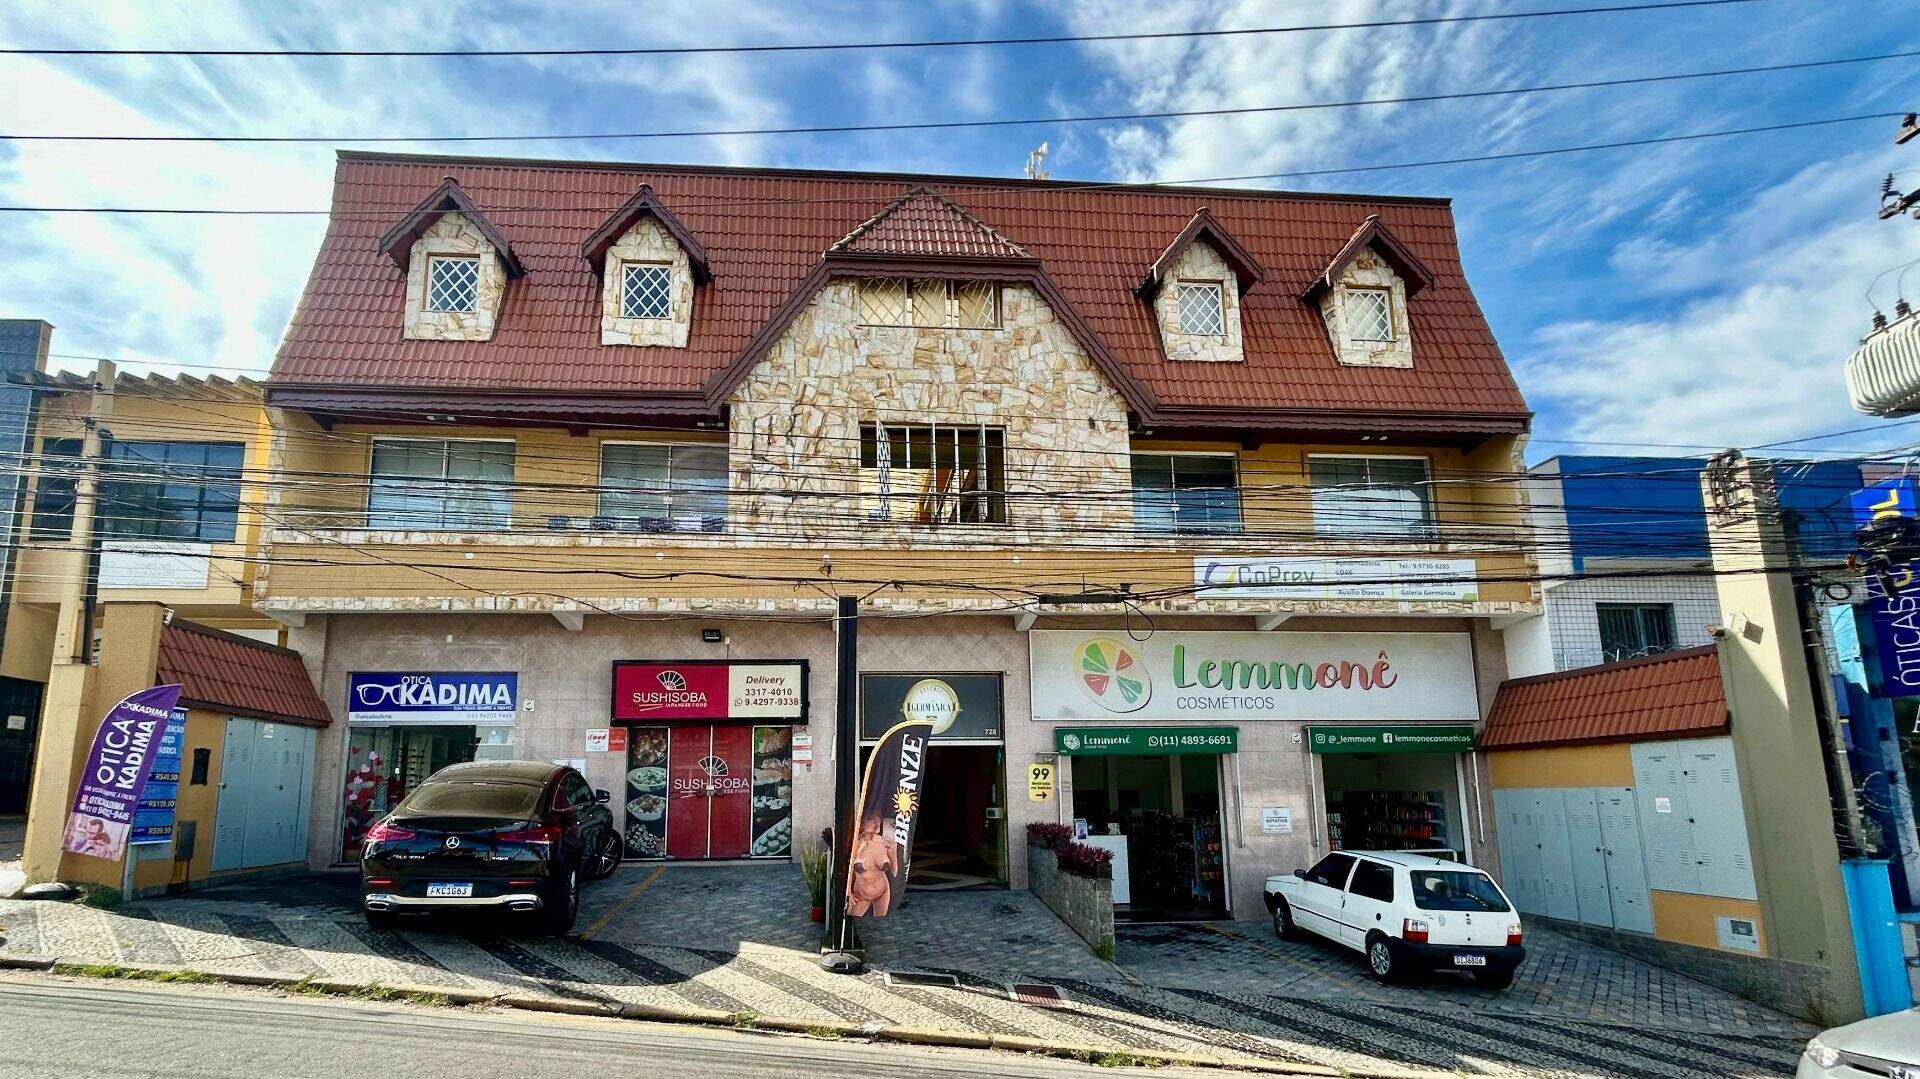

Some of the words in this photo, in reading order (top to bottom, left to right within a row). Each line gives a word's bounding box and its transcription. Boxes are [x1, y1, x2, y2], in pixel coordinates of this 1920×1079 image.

[1172, 644, 1398, 691] Lemmonê
[746, 675, 785, 686] Delivery
[400, 683, 512, 704] KADIMA
[632, 692, 708, 703] SUSHISOBA
[745, 688, 793, 696] 3317-4010
[1176, 693, 1275, 710] COSMÉTICOS
[134, 703, 168, 719] KADIMA
[984, 728, 997, 736] 728
[1160, 736, 1179, 747] (11)
[1180, 735, 1232, 745] 4893-6691
[96, 719, 136, 784] OTICA
[115, 720, 158, 790] KADIMA
[1032, 767, 1050, 780] 99
[673, 777, 750, 790] SUSHSOBA
